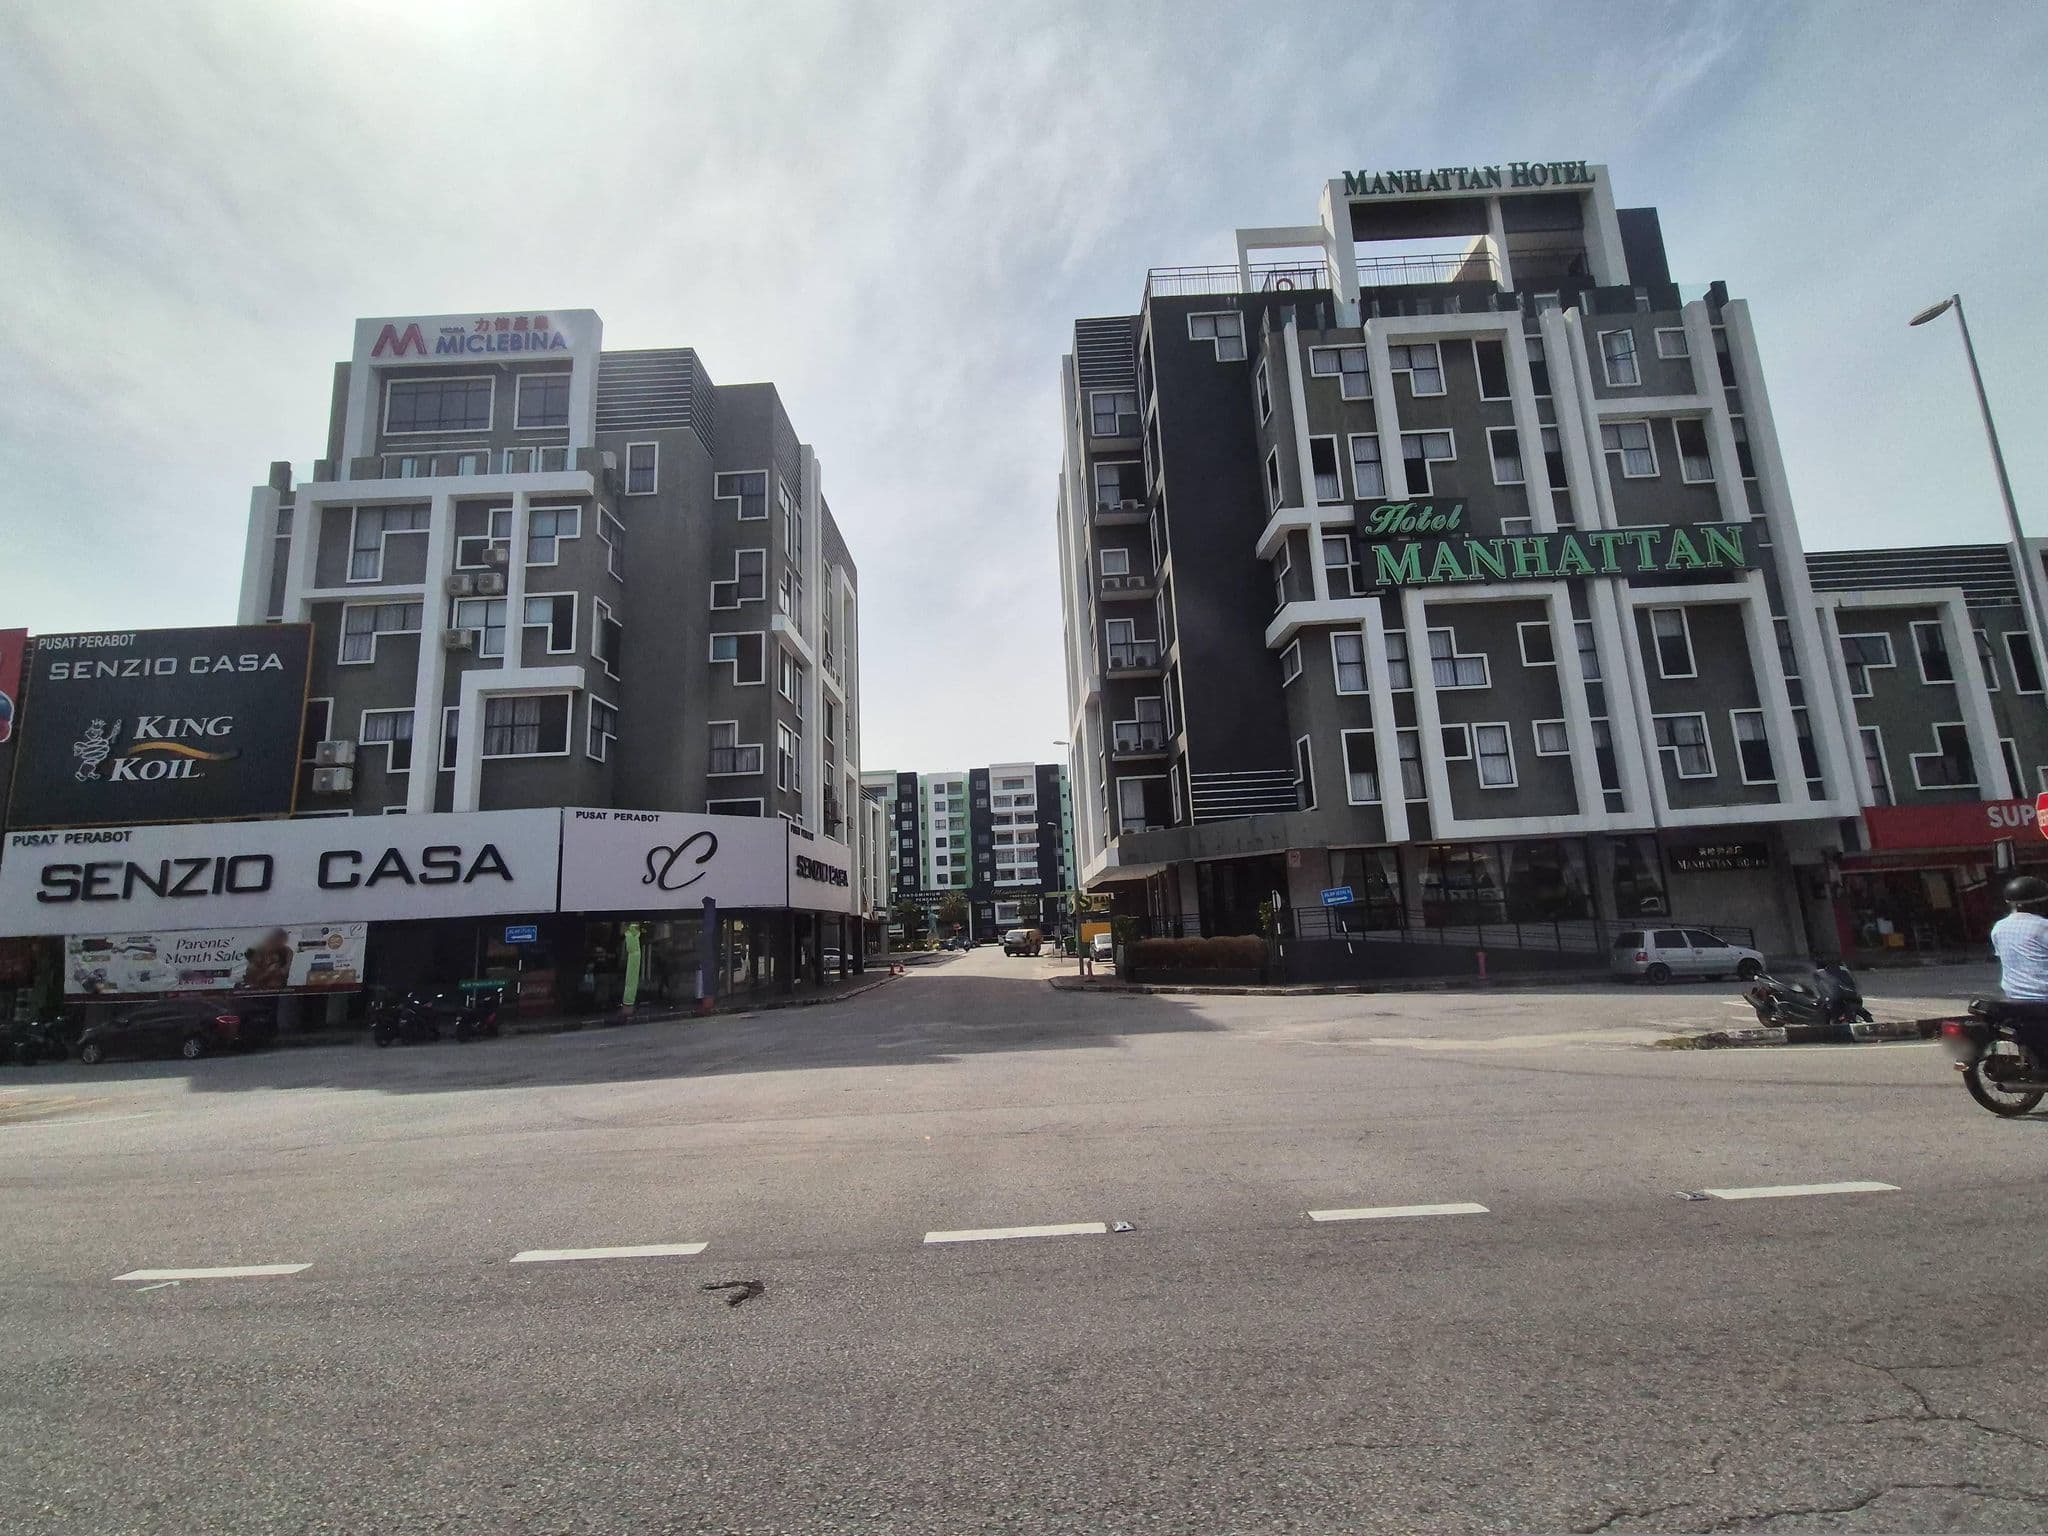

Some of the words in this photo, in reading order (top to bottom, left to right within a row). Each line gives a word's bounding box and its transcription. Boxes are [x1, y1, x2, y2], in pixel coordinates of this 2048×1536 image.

[1342, 165, 1501, 196] MANHATTAN
[1508, 160, 1596, 187] HOTEL
[435, 331, 567, 354] MICLEBINA
[1365, 502, 1463, 536] Hotel
[1371, 526, 1747, 585] MANHATTAN
[38, 636, 77, 650] PUSAT
[79, 633, 136, 648] PERABOT
[49, 657, 178, 681] SENZIO
[190, 653, 284, 675] CASA
[133, 715, 234, 740] KING
[109, 757, 203, 782] KOIL
[576, 811, 608, 820] PUSAT
[614, 812, 660, 823] PERABOT
[12, 833, 58, 847] PUSAT
[64, 830, 132, 844] PERABOT
[36, 853, 275, 904] SENZIO
[317, 843, 513, 890] CASA
[165, 951, 212, 965] Month
